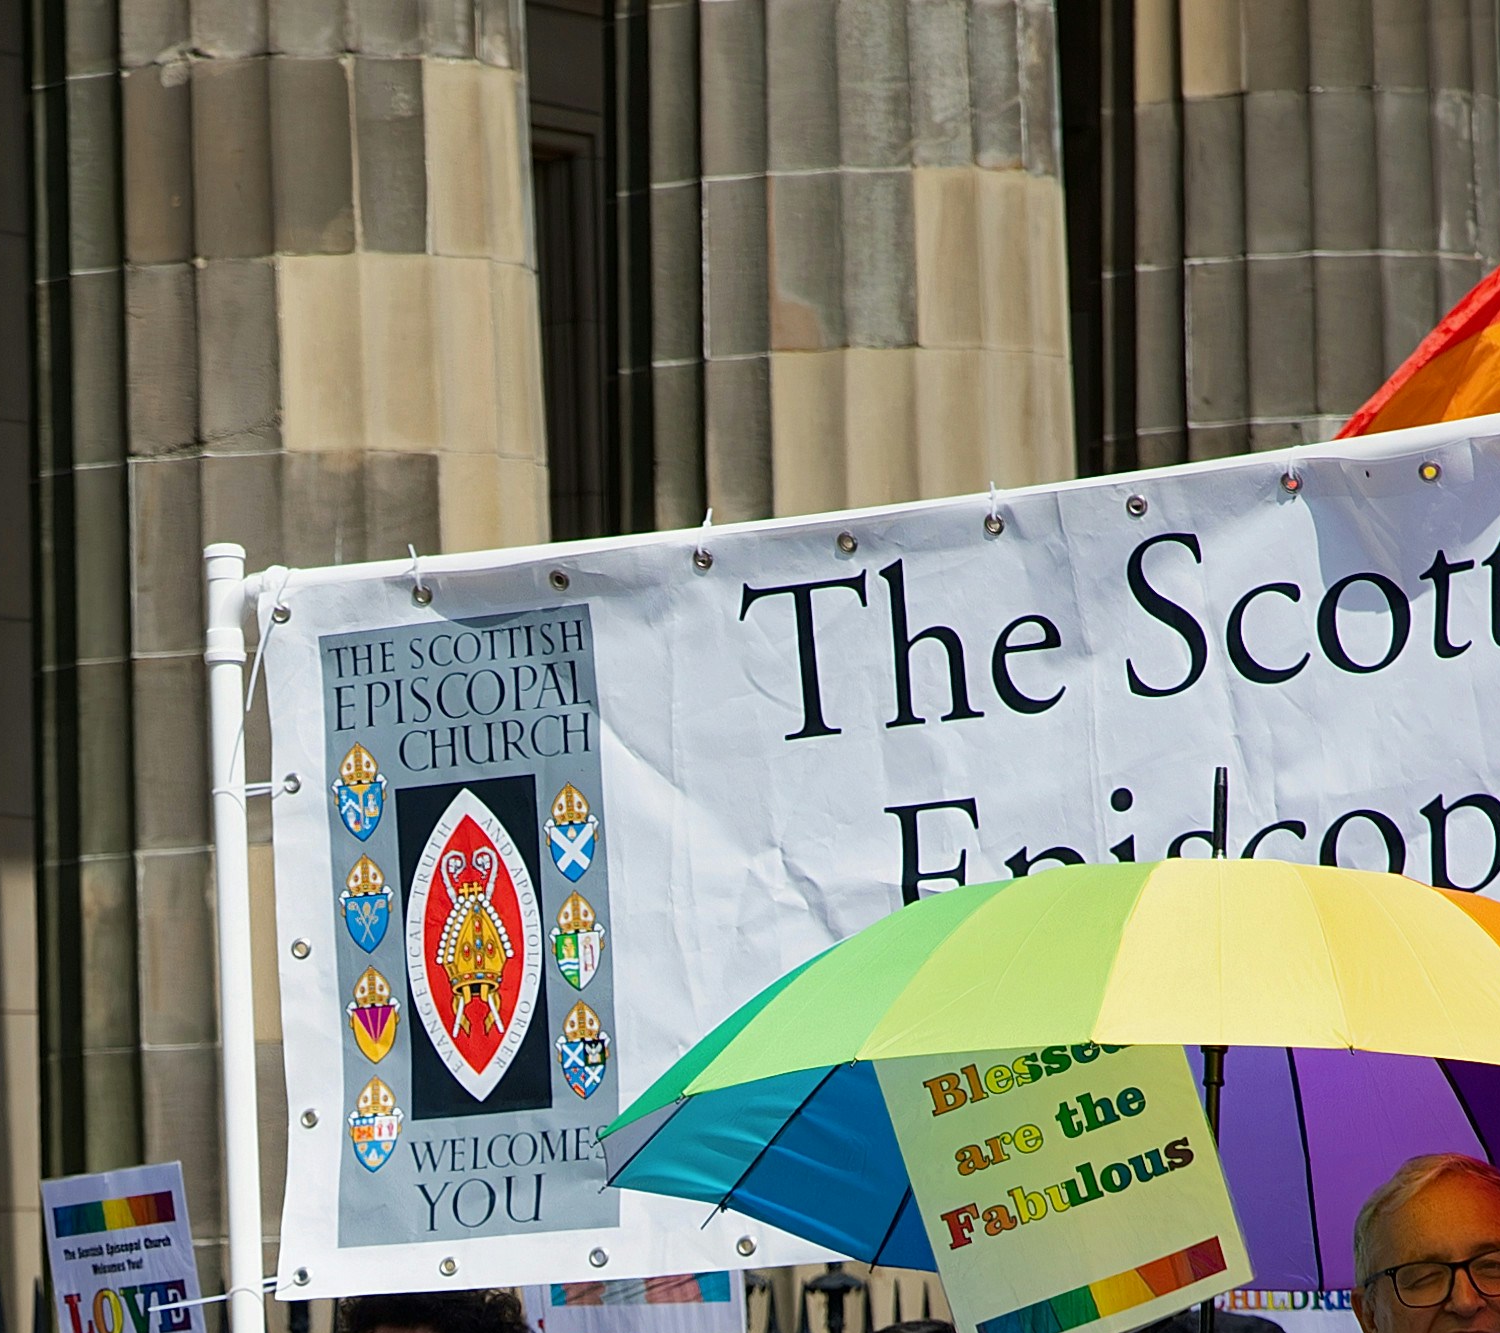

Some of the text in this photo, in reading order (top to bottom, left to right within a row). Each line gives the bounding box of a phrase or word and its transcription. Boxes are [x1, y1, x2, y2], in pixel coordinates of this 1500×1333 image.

[328, 619, 586, 679] THE SCOTTISH
[739, 560, 1065, 741] The
[333, 660, 592, 733] EPISCOPAL
[399, 713, 592, 772] CHURCH
[409, 822, 462, 1074] EVANGELICAL TRUTH
[481, 817, 540, 1070] AND APOSTOLIC ORDER
[955, 1086, 1147, 1176] are the
[415, 1173, 546, 1232] YOU
[940, 1136, 1195, 1251] Fabulous
